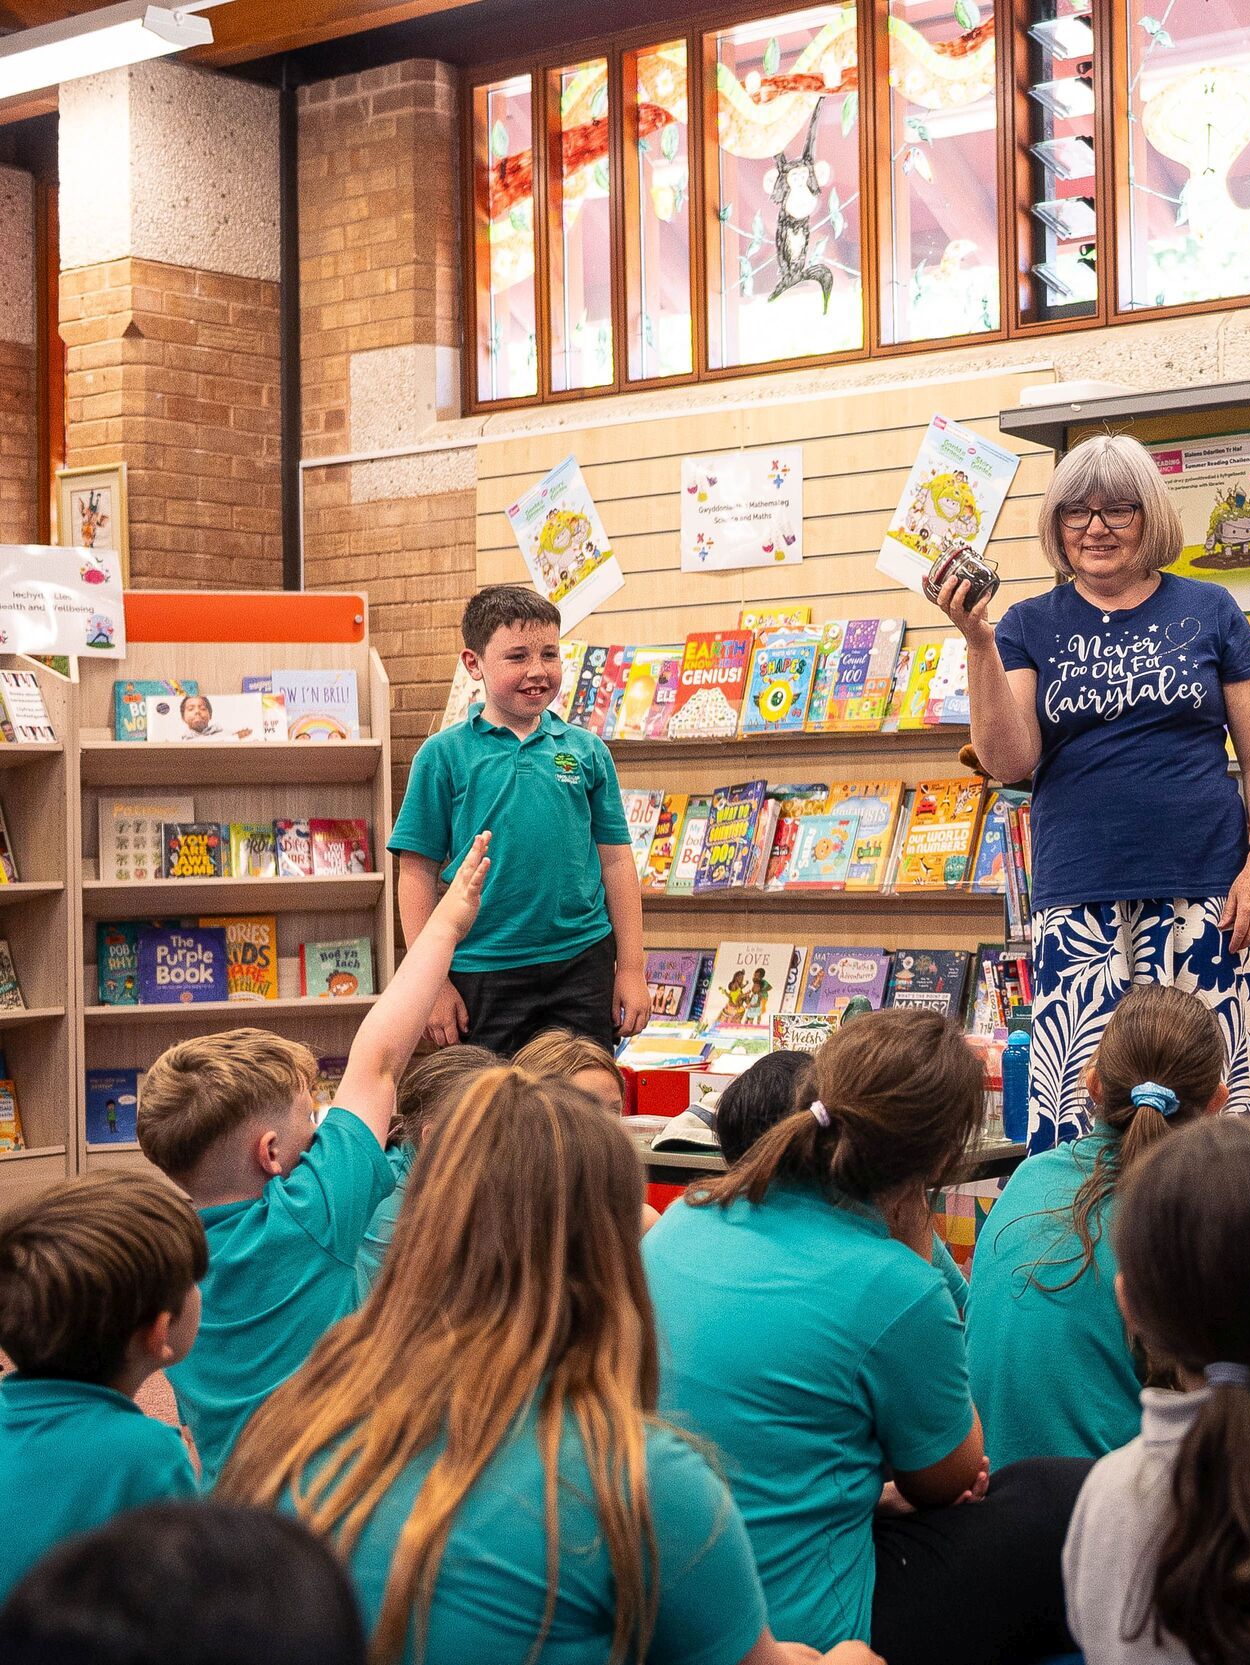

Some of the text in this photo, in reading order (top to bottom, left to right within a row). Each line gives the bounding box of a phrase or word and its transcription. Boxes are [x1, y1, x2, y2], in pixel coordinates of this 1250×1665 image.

[0, 603, 26, 612] ealth
[28, 604, 46, 612] and
[685, 640, 746, 660] EARTH
[1068, 635, 1162, 662] Never
[842, 654, 867, 665] Count
[760, 658, 806, 676] SHAPES
[1058, 655, 1162, 681] Too Old For
[682, 668, 742, 686] GENIUS!
[840, 668, 862, 682] 100
[302, 686, 320, 703] I'N
[324, 686, 350, 703] BRIL!
[1044, 665, 1208, 724] fairytales
[630, 798, 654, 824] BIG
[178, 835, 210, 846] YOU
[926, 830, 969, 842] WORLD
[180, 846, 208, 856] ARE
[710, 844, 735, 865] DO?
[180, 856, 210, 864] AWE
[174, 864, 215, 876] SOME
[227, 924, 270, 944] ORIES
[171, 935, 194, 948] The
[156, 944, 213, 968] Purple
[320, 950, 357, 962] Bod yn
[335, 958, 360, 968] Iach
[736, 954, 770, 966] LOVE
[156, 964, 214, 985] Book
[895, 1000, 947, 1010] MATHS?
[791, 1030, 824, 1044] Welsh
